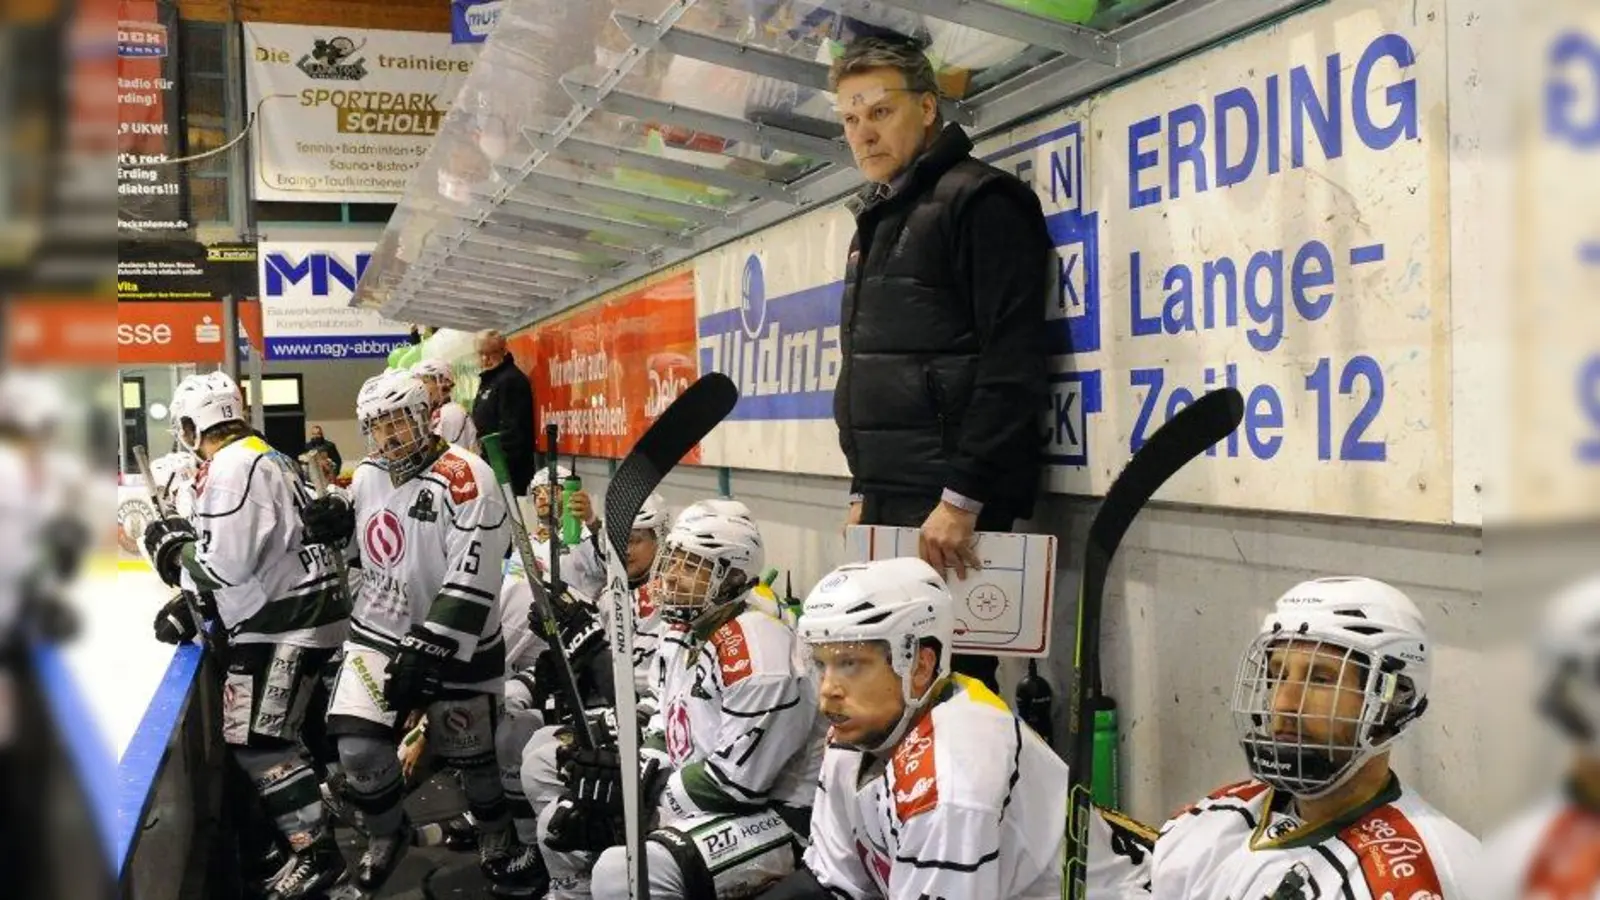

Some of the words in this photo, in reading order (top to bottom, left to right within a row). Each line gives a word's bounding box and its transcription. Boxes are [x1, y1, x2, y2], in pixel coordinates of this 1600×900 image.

[256, 46, 290, 62] Die
[378, 54, 474, 73] trainiere
[154, 78, 174, 90] für
[300, 88, 439, 111] SPORTPARK
[131, 122, 169, 135] UKW!
[345, 112, 439, 134] SCHOLL
[1129, 34, 1418, 210] ERDING
[118, 153, 137, 164] t's
[139, 154, 168, 165] rock
[329, 159, 370, 171] Sauna
[376, 161, 409, 172] Bistro
[118, 183, 179, 195] diators!!!
[118, 322, 172, 345] sse
[221, 405, 234, 419] 13
[1305, 355, 1386, 462] 12
[614, 592, 626, 654] EASTON
